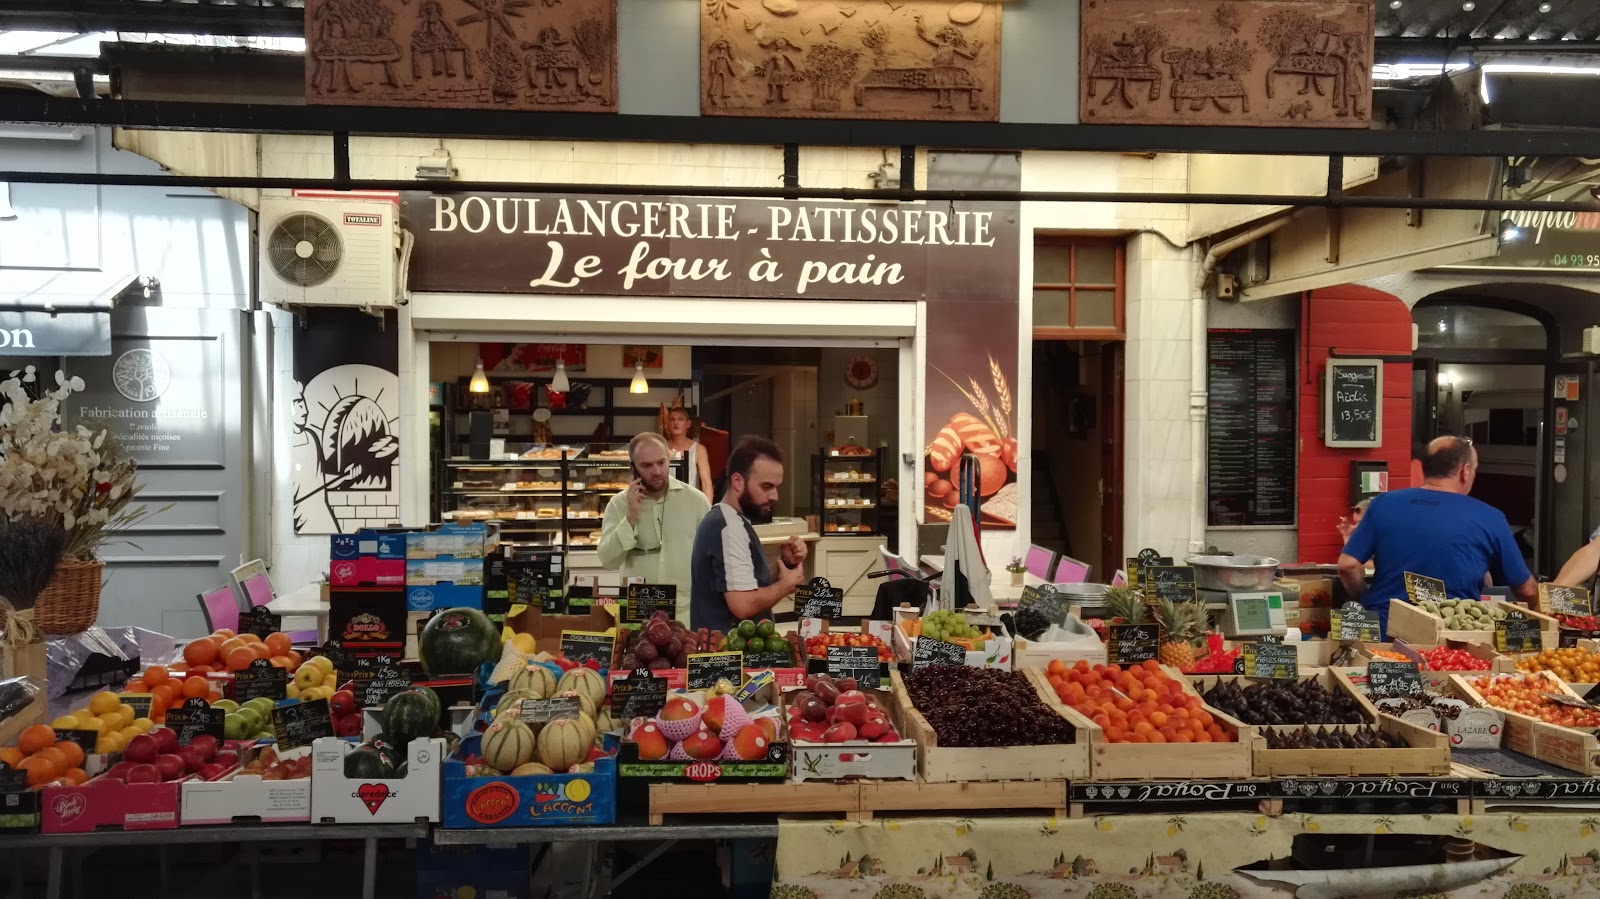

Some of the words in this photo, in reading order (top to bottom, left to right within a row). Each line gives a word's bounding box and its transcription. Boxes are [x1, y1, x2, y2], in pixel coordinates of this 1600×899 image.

[346, 216, 379, 224] TOTALINE
[429, 196, 740, 241] BOULANGERIE
[767, 205, 997, 249] PATISSERIE
[1554, 254, 1567, 266] 04
[1570, 255, 1584, 266] 93
[1586, 255, 1600, 267] 95
[529, 240, 603, 289] Le
[617, 240, 732, 290] four
[748, 252, 784, 283] à
[796, 253, 905, 294] pain
[80, 406, 148, 419] Fabrication
[151, 406, 208, 419] artisanale
[150, 433, 181, 442] niçoises
[335, 537, 355, 546] JAZZ
[1262, 634, 1276, 644] 1Kg
[1244, 644, 1258, 654] Prix
[254, 659, 267, 667] 1Kg
[376, 655, 391, 665] 1Kg
[235, 672, 249, 680] Prix
[353, 670, 369, 679] Prix
[635, 667, 648, 677] 1Kg
[613, 684, 628, 692] Prix
[190, 698, 204, 708] 1Kg
[166, 712, 182, 721] Prix
[1457, 726, 1489, 735] LAZARE
[685, 764, 721, 779] TROPS
[1137, 782, 1235, 802] Royal
[1236, 784, 1257, 797] Sun
[1344, 779, 1435, 799] Royal
[351, 790, 397, 799] cuoredolce
